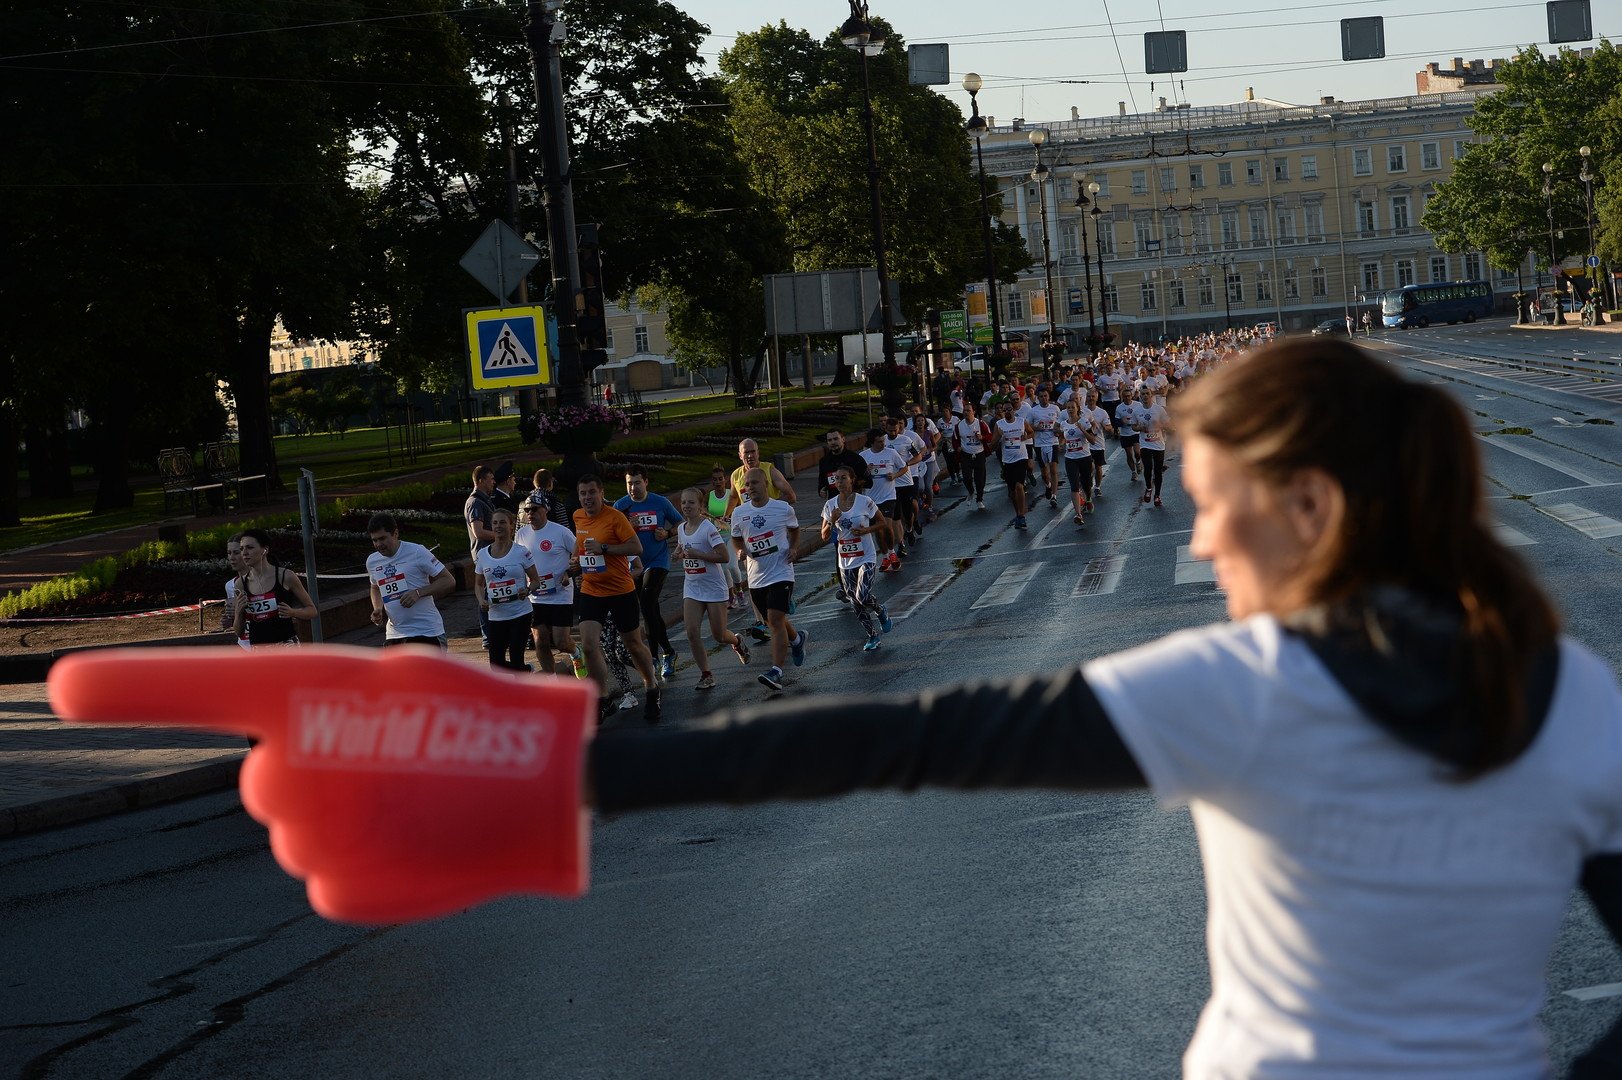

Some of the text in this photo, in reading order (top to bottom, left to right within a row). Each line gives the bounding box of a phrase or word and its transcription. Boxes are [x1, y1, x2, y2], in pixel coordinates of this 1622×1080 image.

[943, 320, 963, 328] ТАКСИ
[640, 516, 653, 526] 15
[751, 538, 771, 552] 501
[841, 543, 858, 553] 623
[584, 556, 596, 566] 10
[684, 559, 700, 569] 605
[385, 582, 399, 594] 98
[492, 586, 513, 598] 516
[302, 701, 543, 767] World Class
